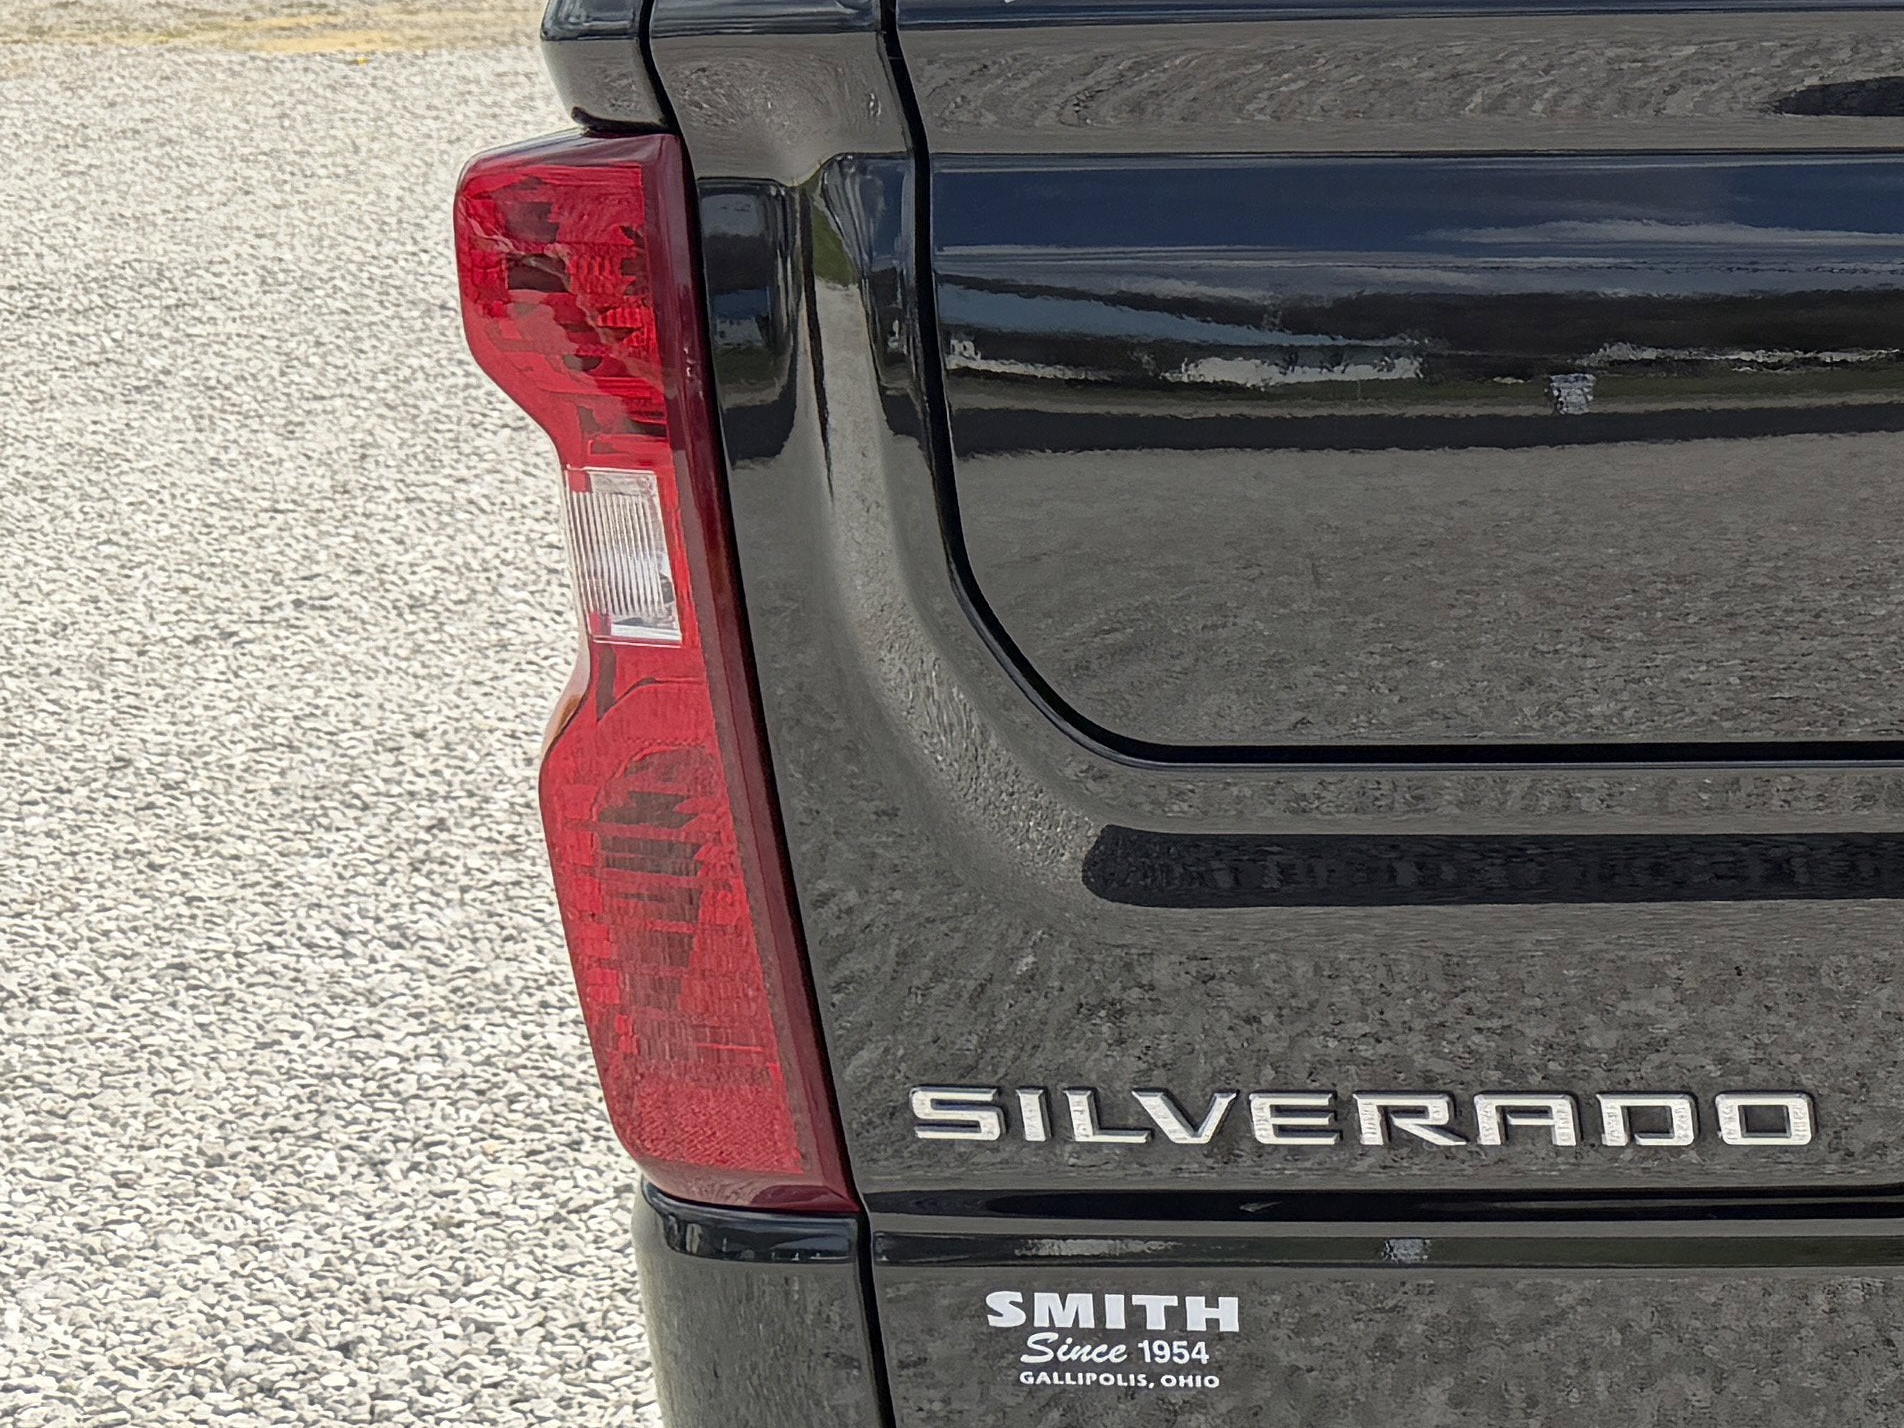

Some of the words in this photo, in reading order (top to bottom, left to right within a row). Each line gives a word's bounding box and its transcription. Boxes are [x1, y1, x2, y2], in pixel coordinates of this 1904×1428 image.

[910, 1085, 1815, 1147] SILVERADO
[986, 1291, 1240, 1332] SMITH
[1020, 1332, 1128, 1363] Since
[1137, 1339, 1209, 1364] 1954
[1019, 1371, 1155, 1389] GALLIPOLIS,
[1160, 1374, 1220, 1388] OHIO
